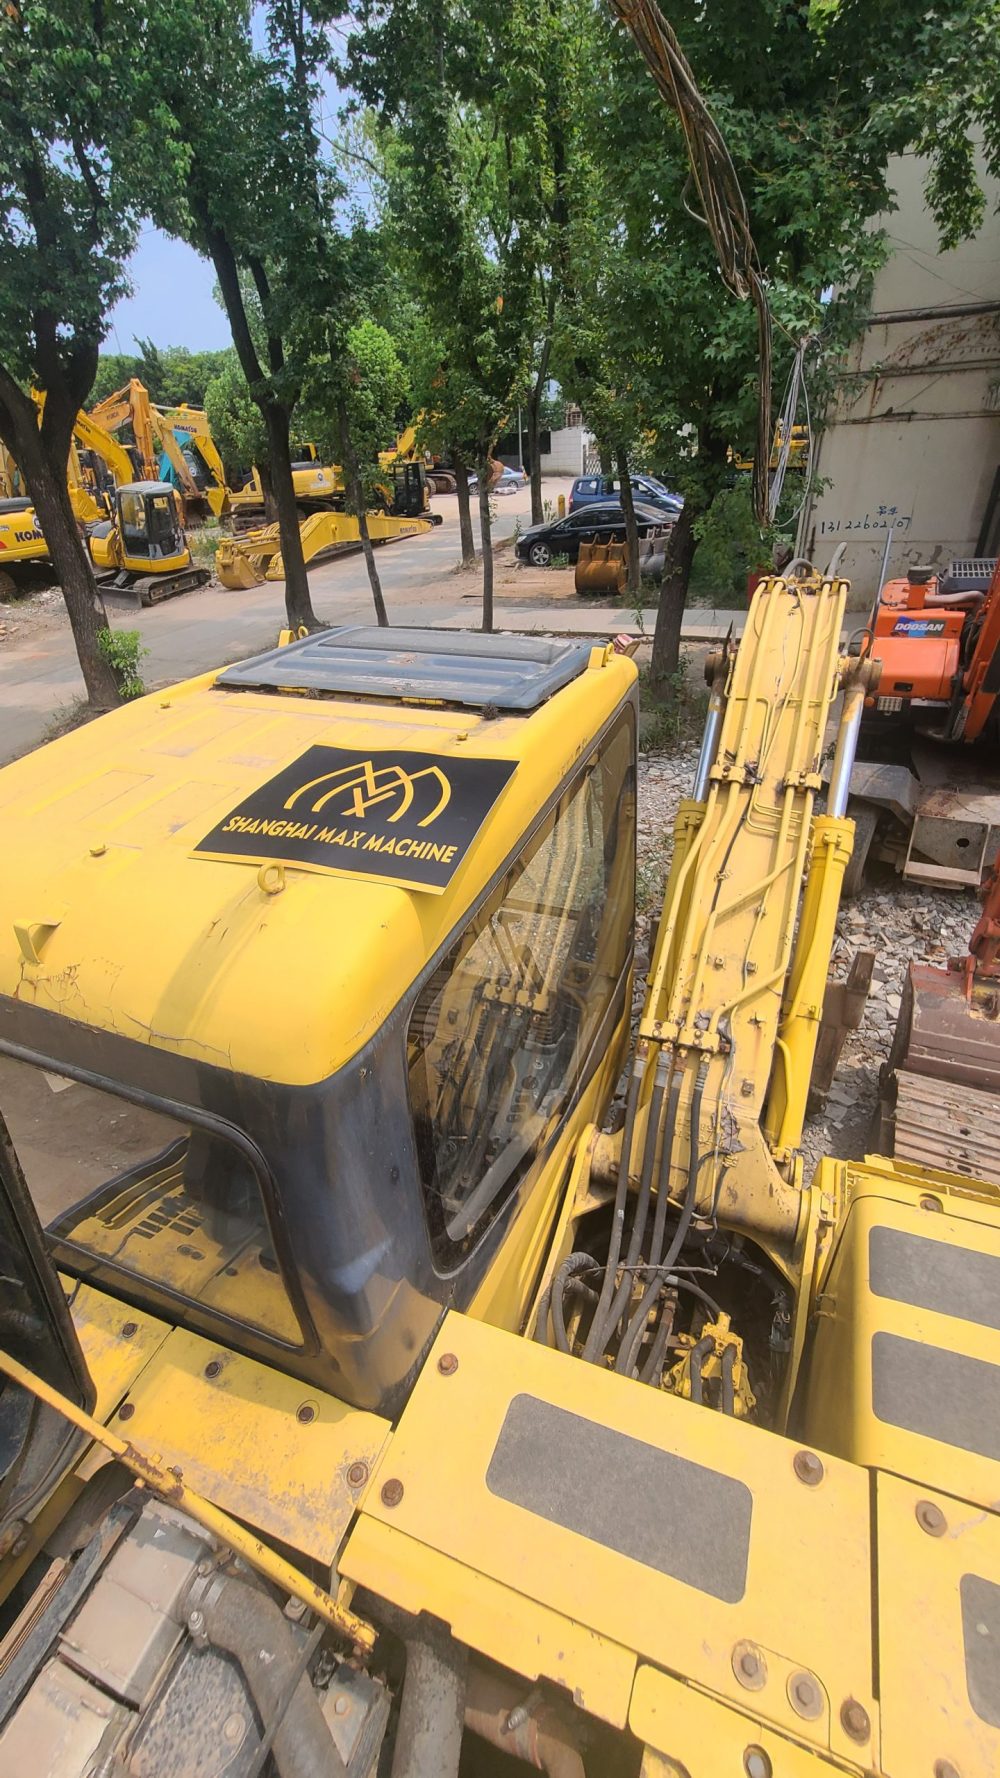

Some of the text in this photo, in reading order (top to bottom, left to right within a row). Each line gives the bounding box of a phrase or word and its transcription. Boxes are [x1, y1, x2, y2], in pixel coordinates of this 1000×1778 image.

[894, 622, 945, 631] DOOSAN
[222, 815, 458, 864] SHANGHAI MAX MACHINE
